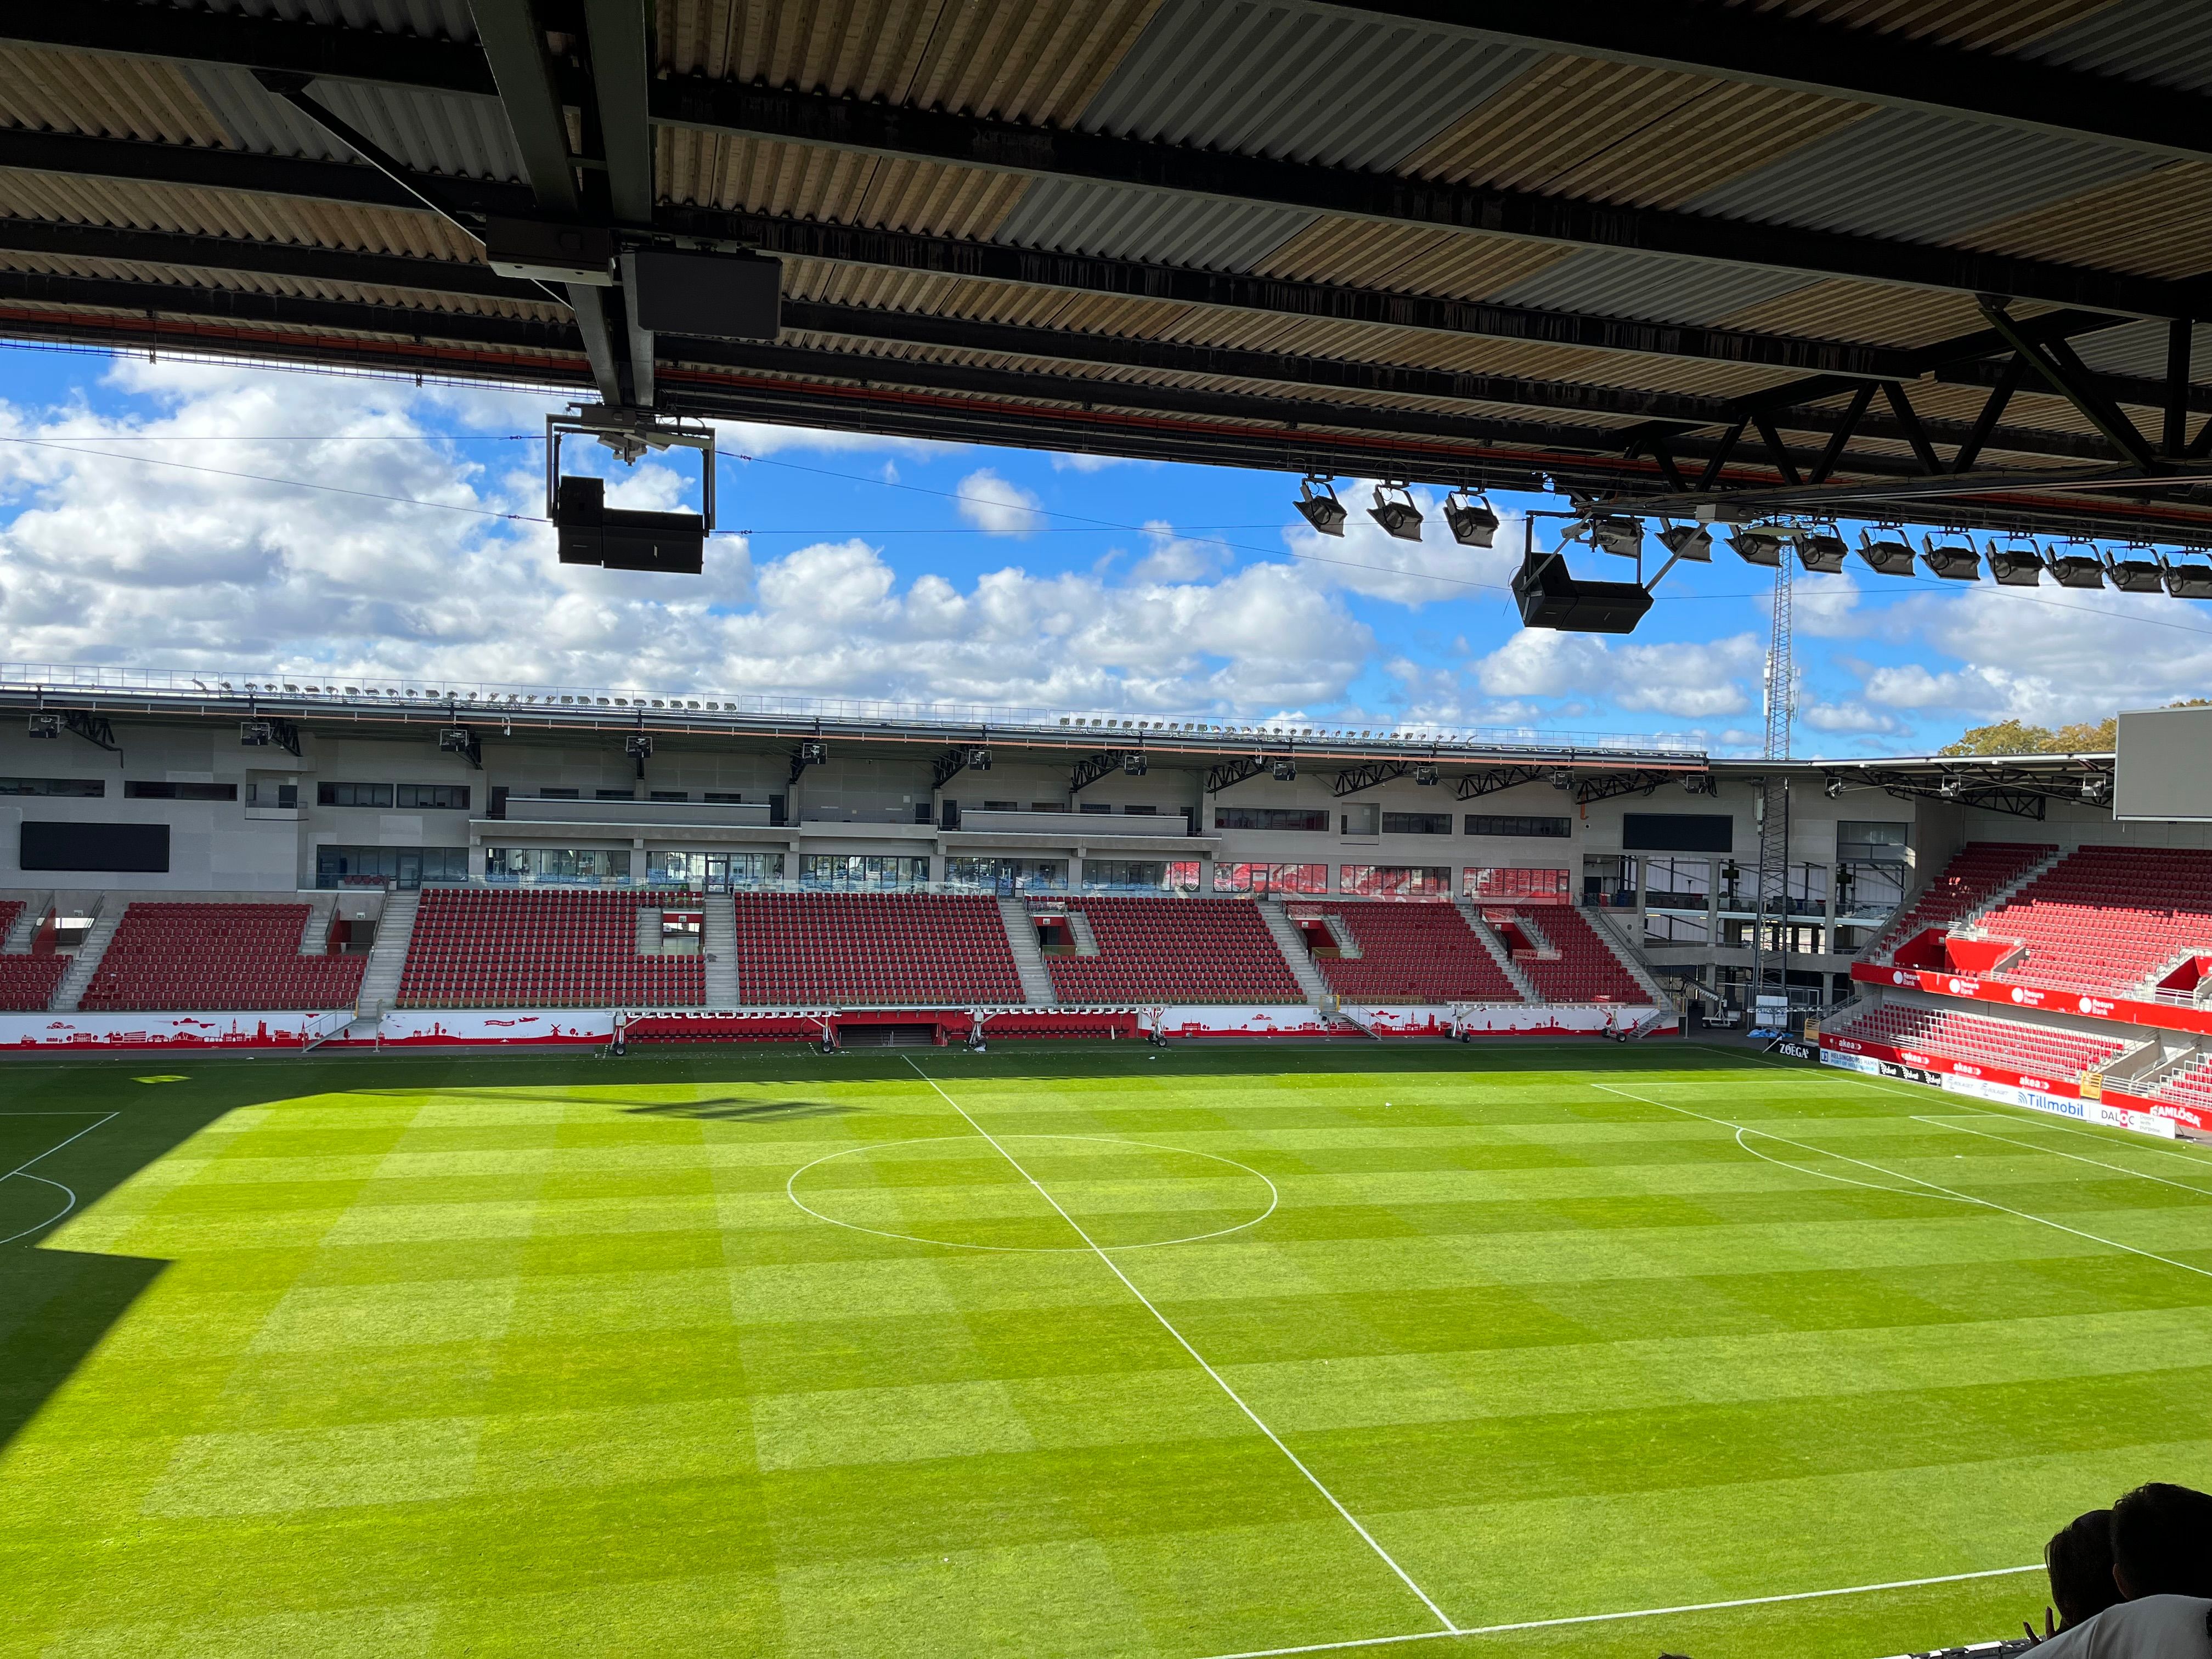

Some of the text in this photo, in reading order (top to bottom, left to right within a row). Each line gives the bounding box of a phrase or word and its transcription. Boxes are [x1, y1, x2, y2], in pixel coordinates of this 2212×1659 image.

[1903, 972, 1920, 981] Resurs
[1960, 981, 1979, 990] Resurs
[2024, 989, 2044, 999] Resurs
[2092, 999, 2114, 1009] Resurs
[2092, 1007, 2108, 1015] Bank
[1839, 1039, 1854, 1049] akea
[1903, 1052, 1921, 1063] akea
[1953, 1062, 1973, 1074] akea
[2019, 1075, 2040, 1088] akea
[2028, 1093, 2084, 1116] Tillmobil
[2101, 1110, 2135, 1125] DALOC
